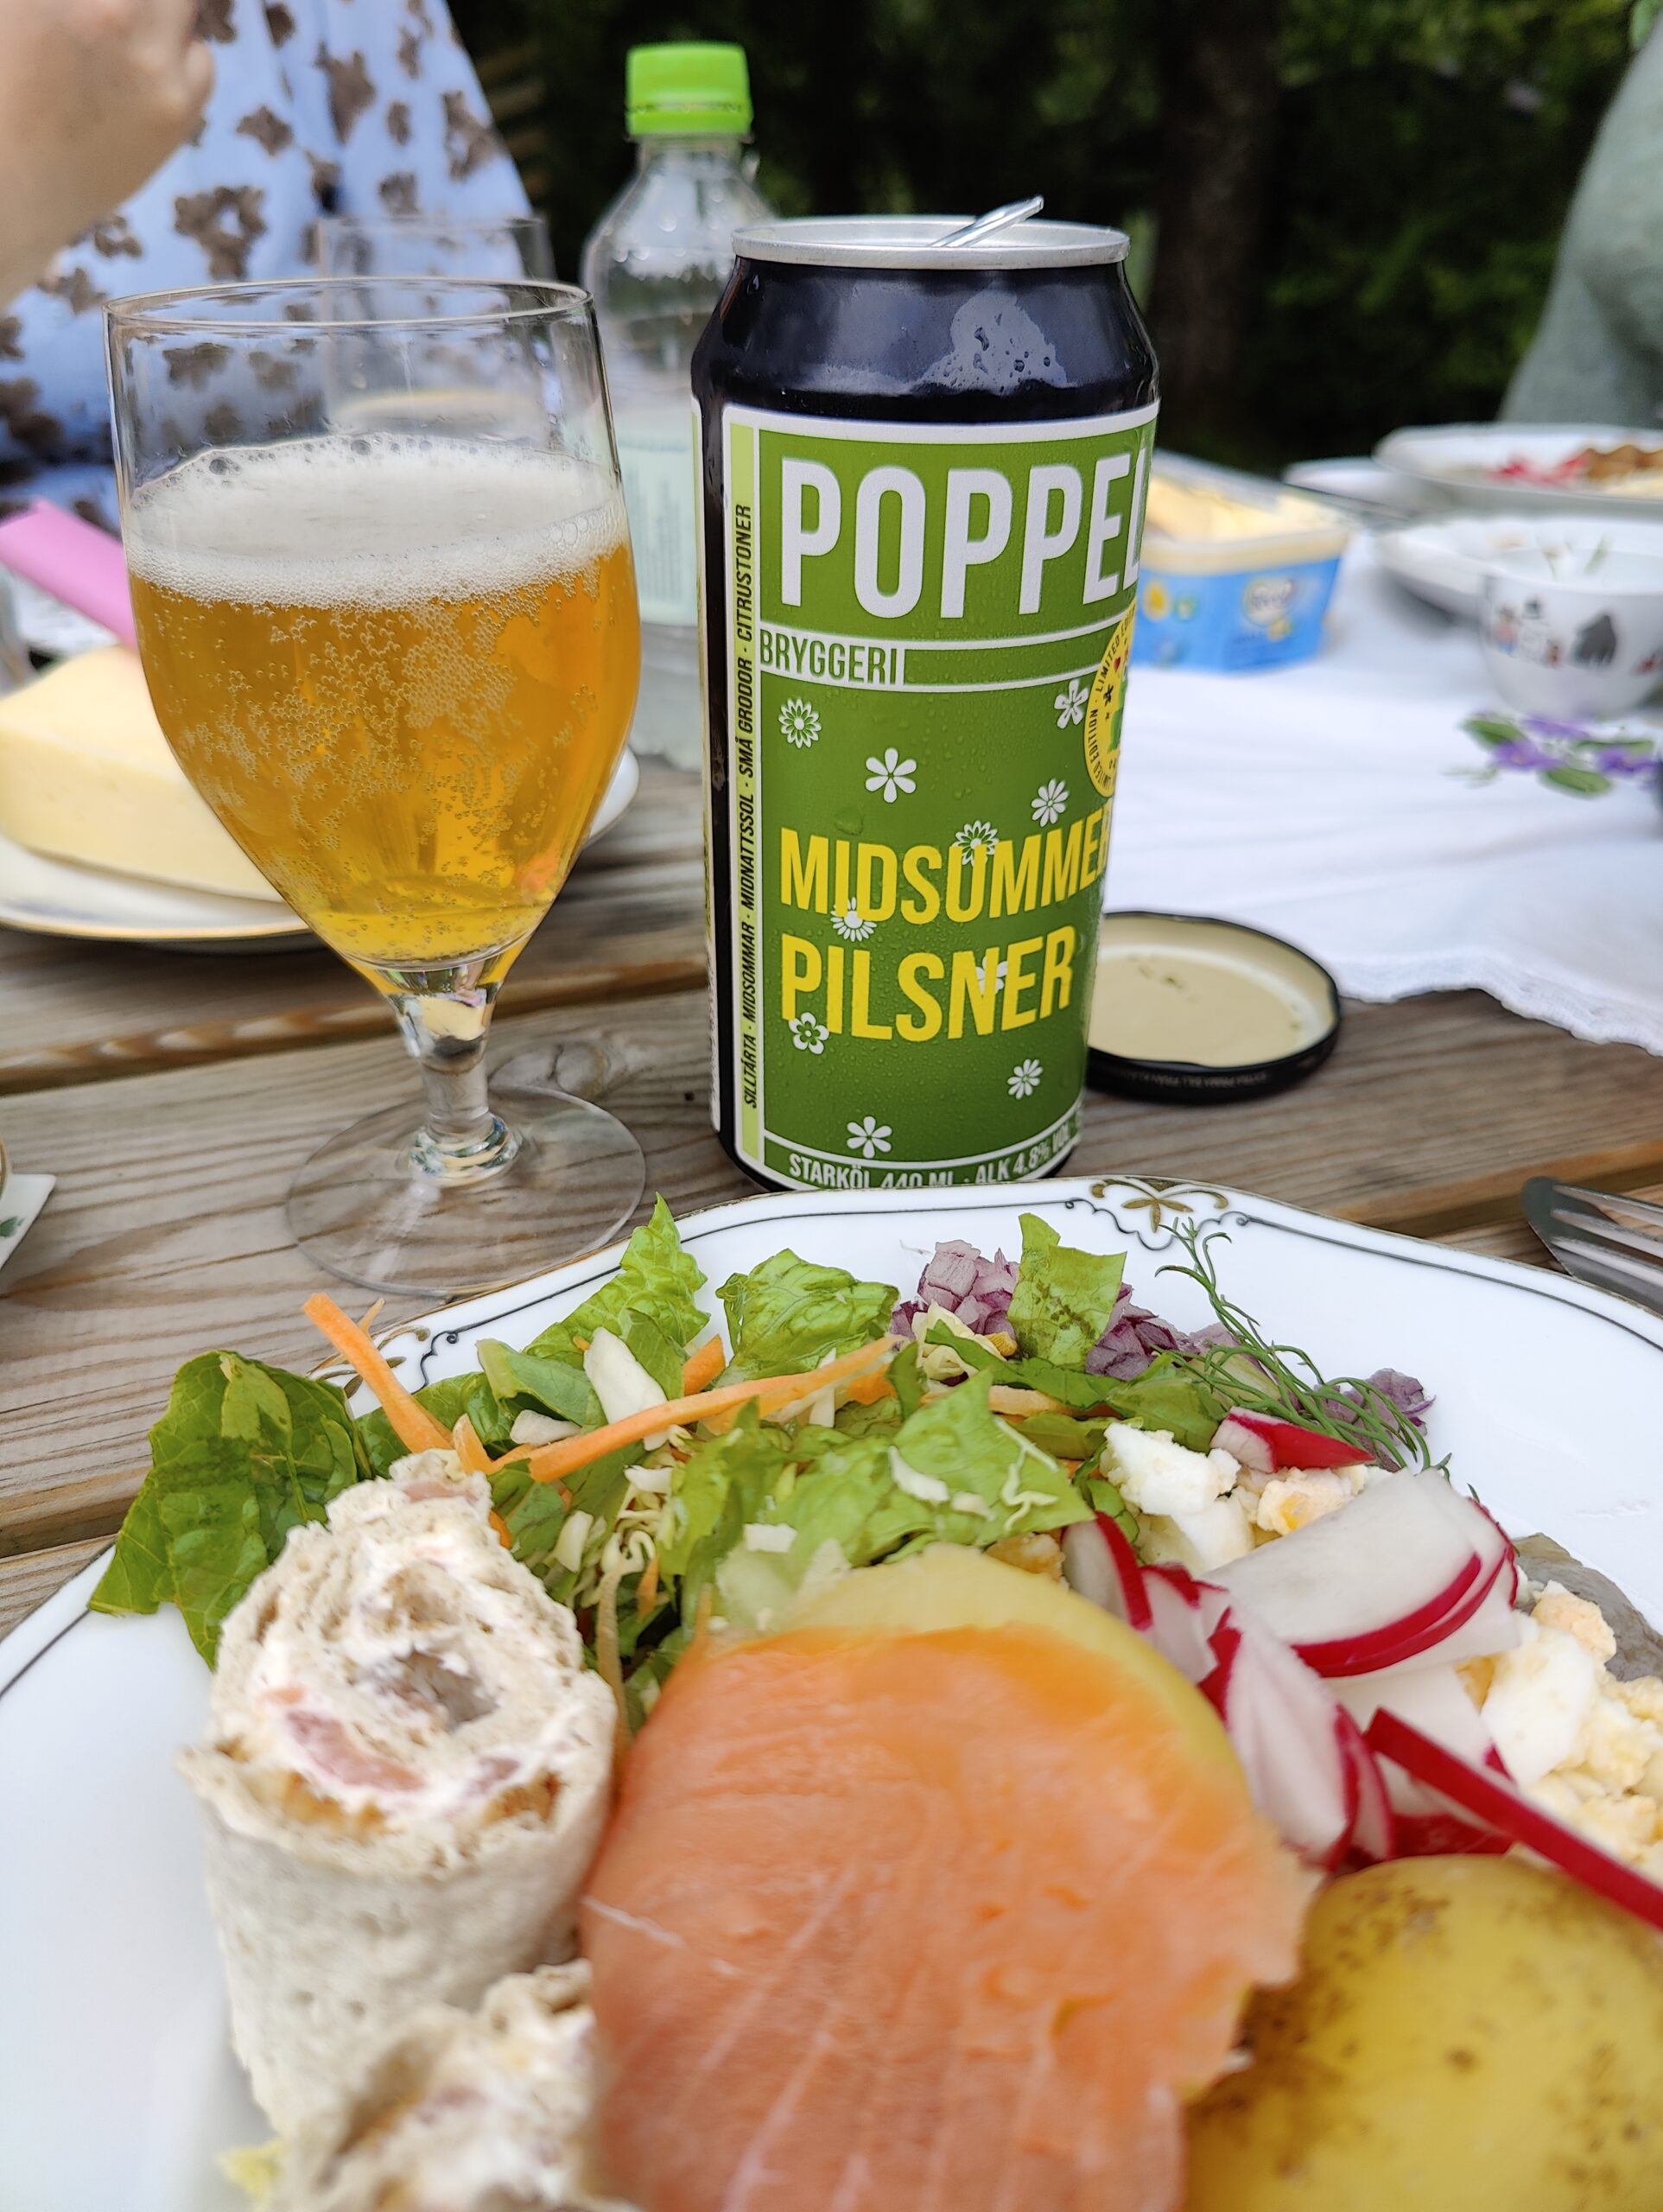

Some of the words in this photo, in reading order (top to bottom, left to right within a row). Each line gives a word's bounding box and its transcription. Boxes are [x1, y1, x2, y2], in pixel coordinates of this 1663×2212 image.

[735, 504, 752, 642] CITRUSTONER
[760, 628, 898, 685] BRYGGERI
[1095, 634, 1120, 693] LIMITED
[737, 657, 753, 734] GRODOR
[734, 737, 753, 779] SMÅ
[1088, 709, 1100, 764] EDITION
[739, 794, 755, 911] MIDNATTSSOL
[780, 798, 1113, 925] MIDSUMMER
[741, 921, 756, 1023] MIDSOMMAR
[781, 925, 1076, 1042] PILSNER
[788, 1153, 871, 1189] STARKÖL
[880, 1172, 924, 1188] 440
[974, 1157, 1012, 1184] ALK
